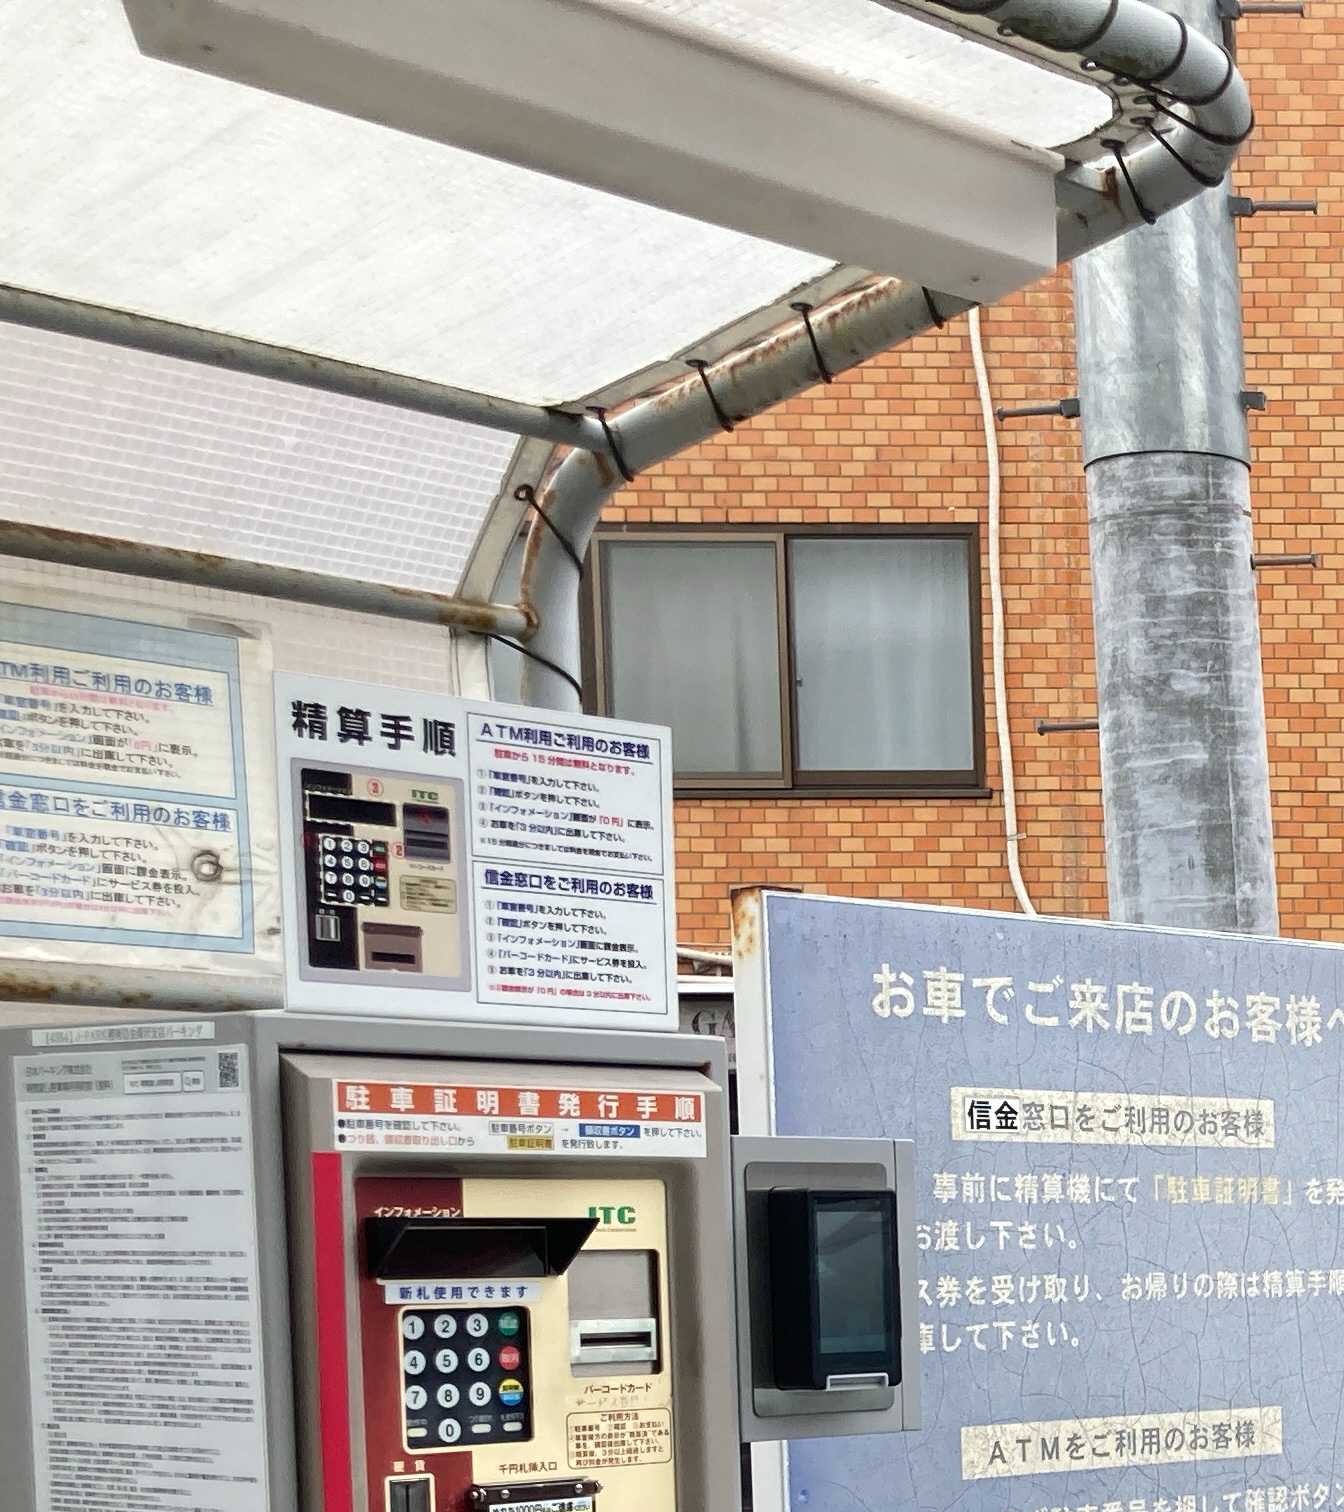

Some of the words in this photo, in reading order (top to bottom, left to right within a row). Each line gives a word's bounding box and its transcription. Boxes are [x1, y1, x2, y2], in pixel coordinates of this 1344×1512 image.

[291, 700, 457, 757] 精算手順
[484, 869, 655, 900] 信金窓口をご利用のお客様
[345, 1085, 696, 1120] 駐車証明書発行手順
[966, 1098, 1266, 1139] 信金窓口をご利用のお客様
[372, 1206, 462, 1219] インフォメーション
[587, 1205, 636, 1225] ITC
[399, 1286, 529, 1300] 新札使用できます
[584, 1383, 652, 1394] バーコードカード
[989, 1420, 1257, 1467] ATMをご利用のお客様
